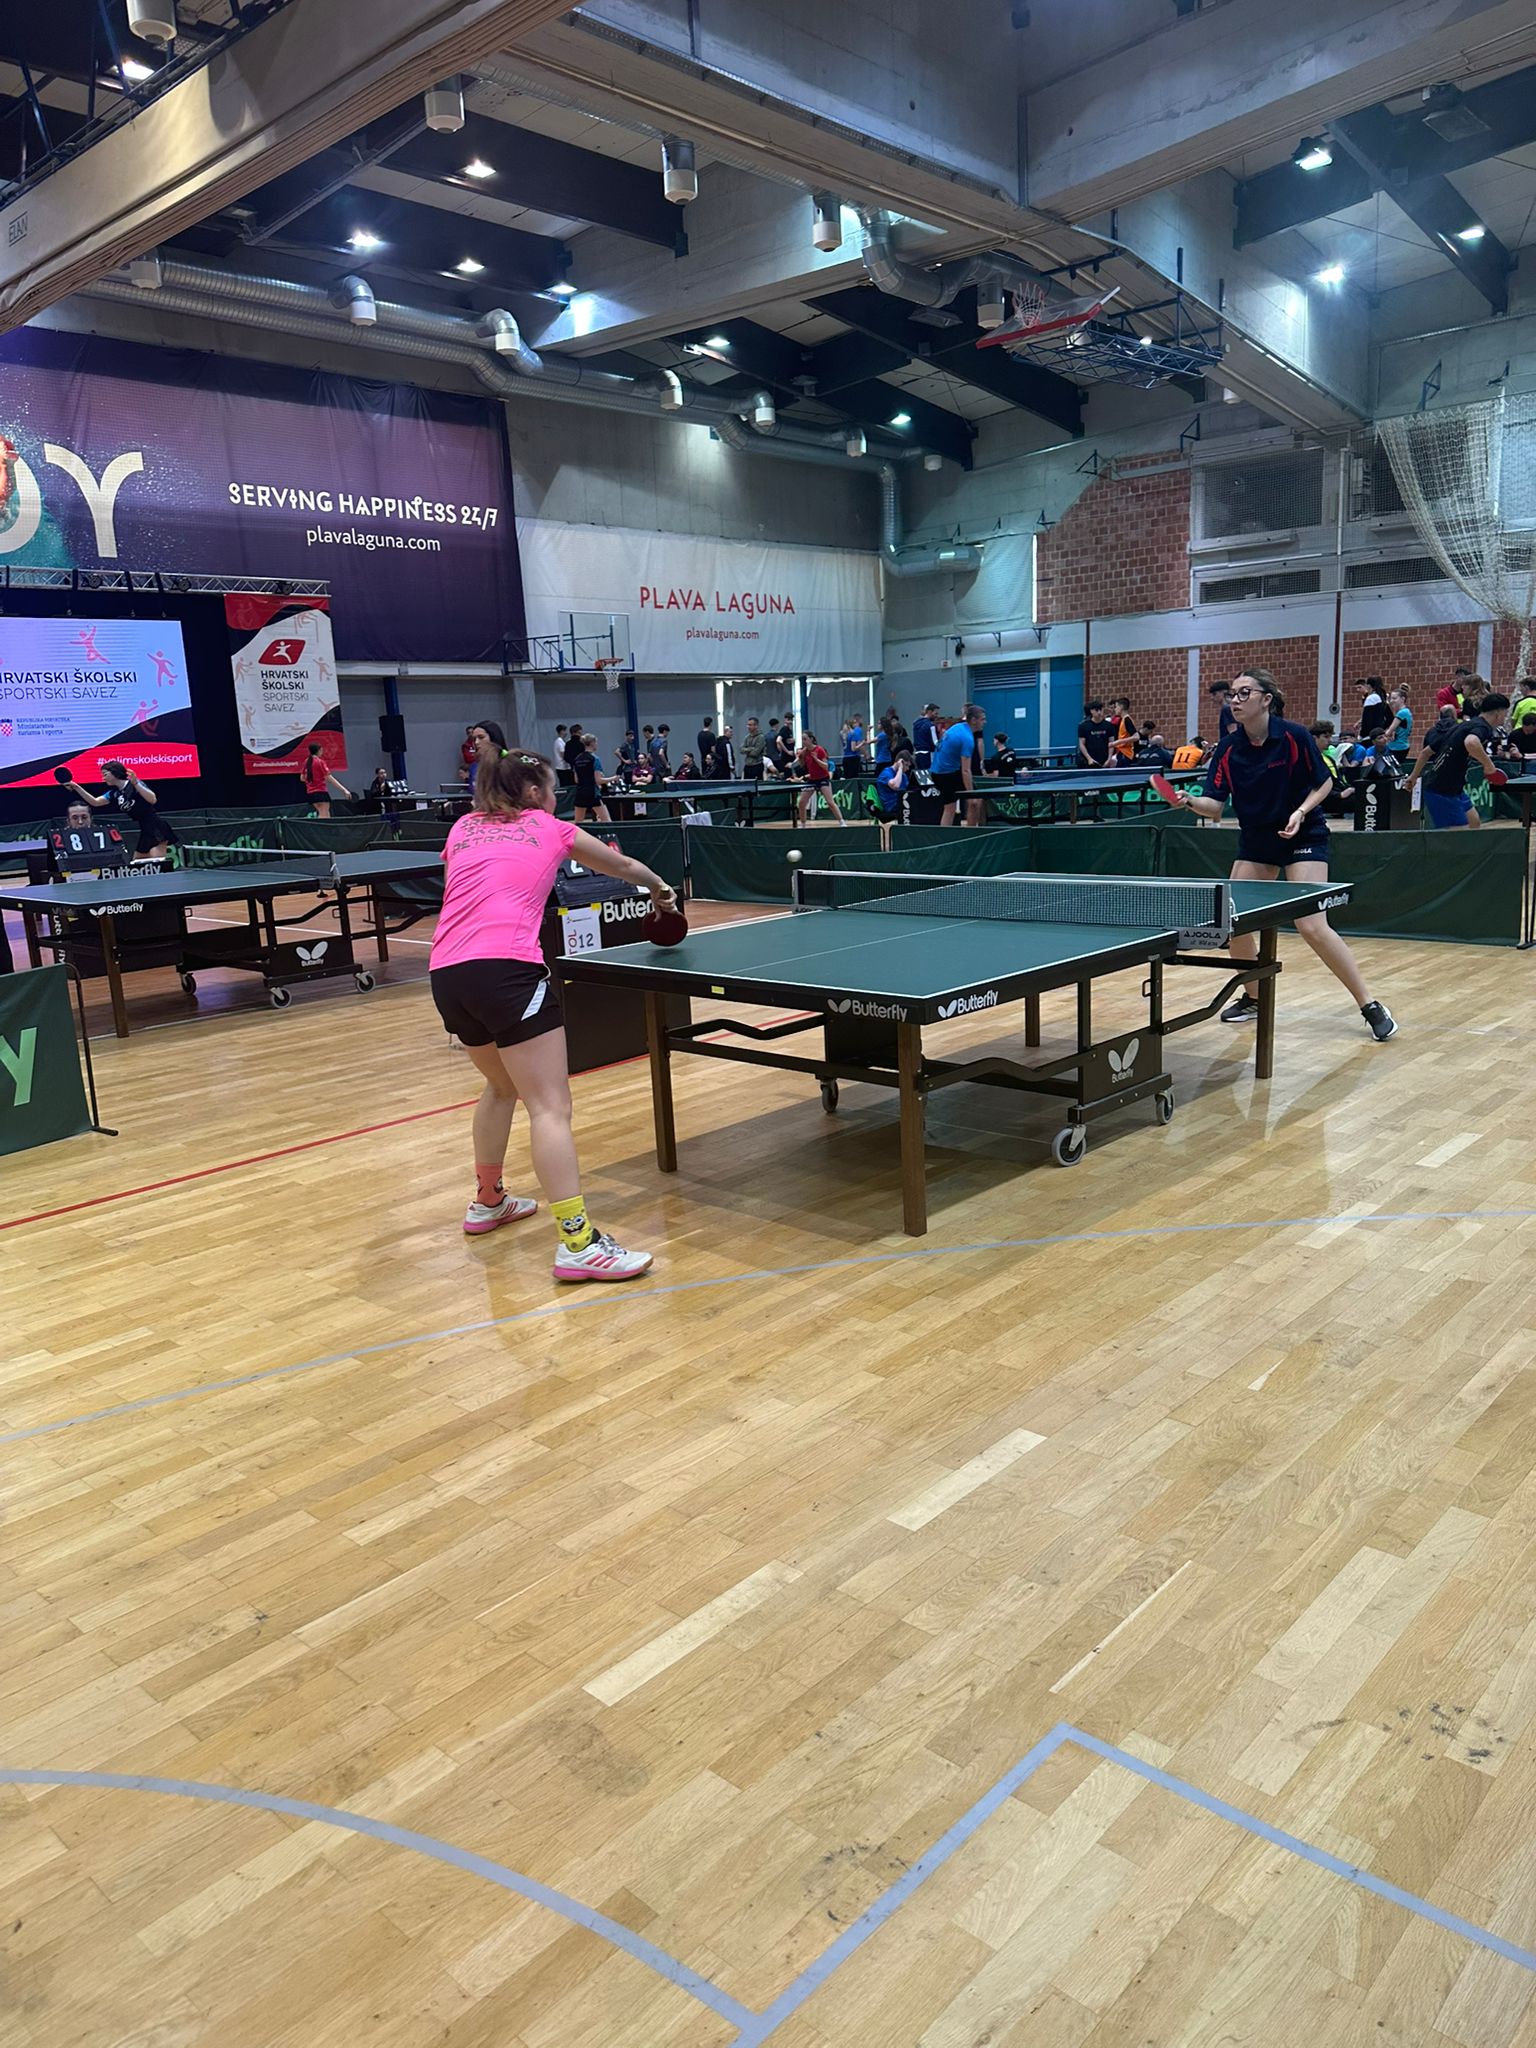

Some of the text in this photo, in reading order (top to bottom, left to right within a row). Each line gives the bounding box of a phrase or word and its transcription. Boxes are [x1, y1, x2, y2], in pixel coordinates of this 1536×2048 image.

[228, 482, 498, 531] SERVING HAPPINESS 24/7
[306, 525, 441, 551] plavalaguna.com
[640, 586, 796, 619] PLAVA LAGUNA
[686, 627, 760, 641] plavalaguna.com
[74, 668, 137, 683] ŠKOLSKI
[260, 670, 309, 680] HRVATSKI
[262, 679, 305, 690] ŠKOLSKI
[72, 686, 118, 699] SAVEZ
[263, 691, 309, 701] SPORTSKI
[264, 703, 295, 712] SAVEZ
[1177, 752, 1190, 764] 11
[53, 834, 64, 848] 2
[70, 834, 83, 851] 8
[93, 832, 105, 849] 7
[101, 864, 161, 880] Butterfly
[107, 903, 144, 915] Butterfly
[579, 933, 594, 948] 12
[957, 990, 999, 1014] Butterfly
[852, 1000, 908, 1022] Butterfly
